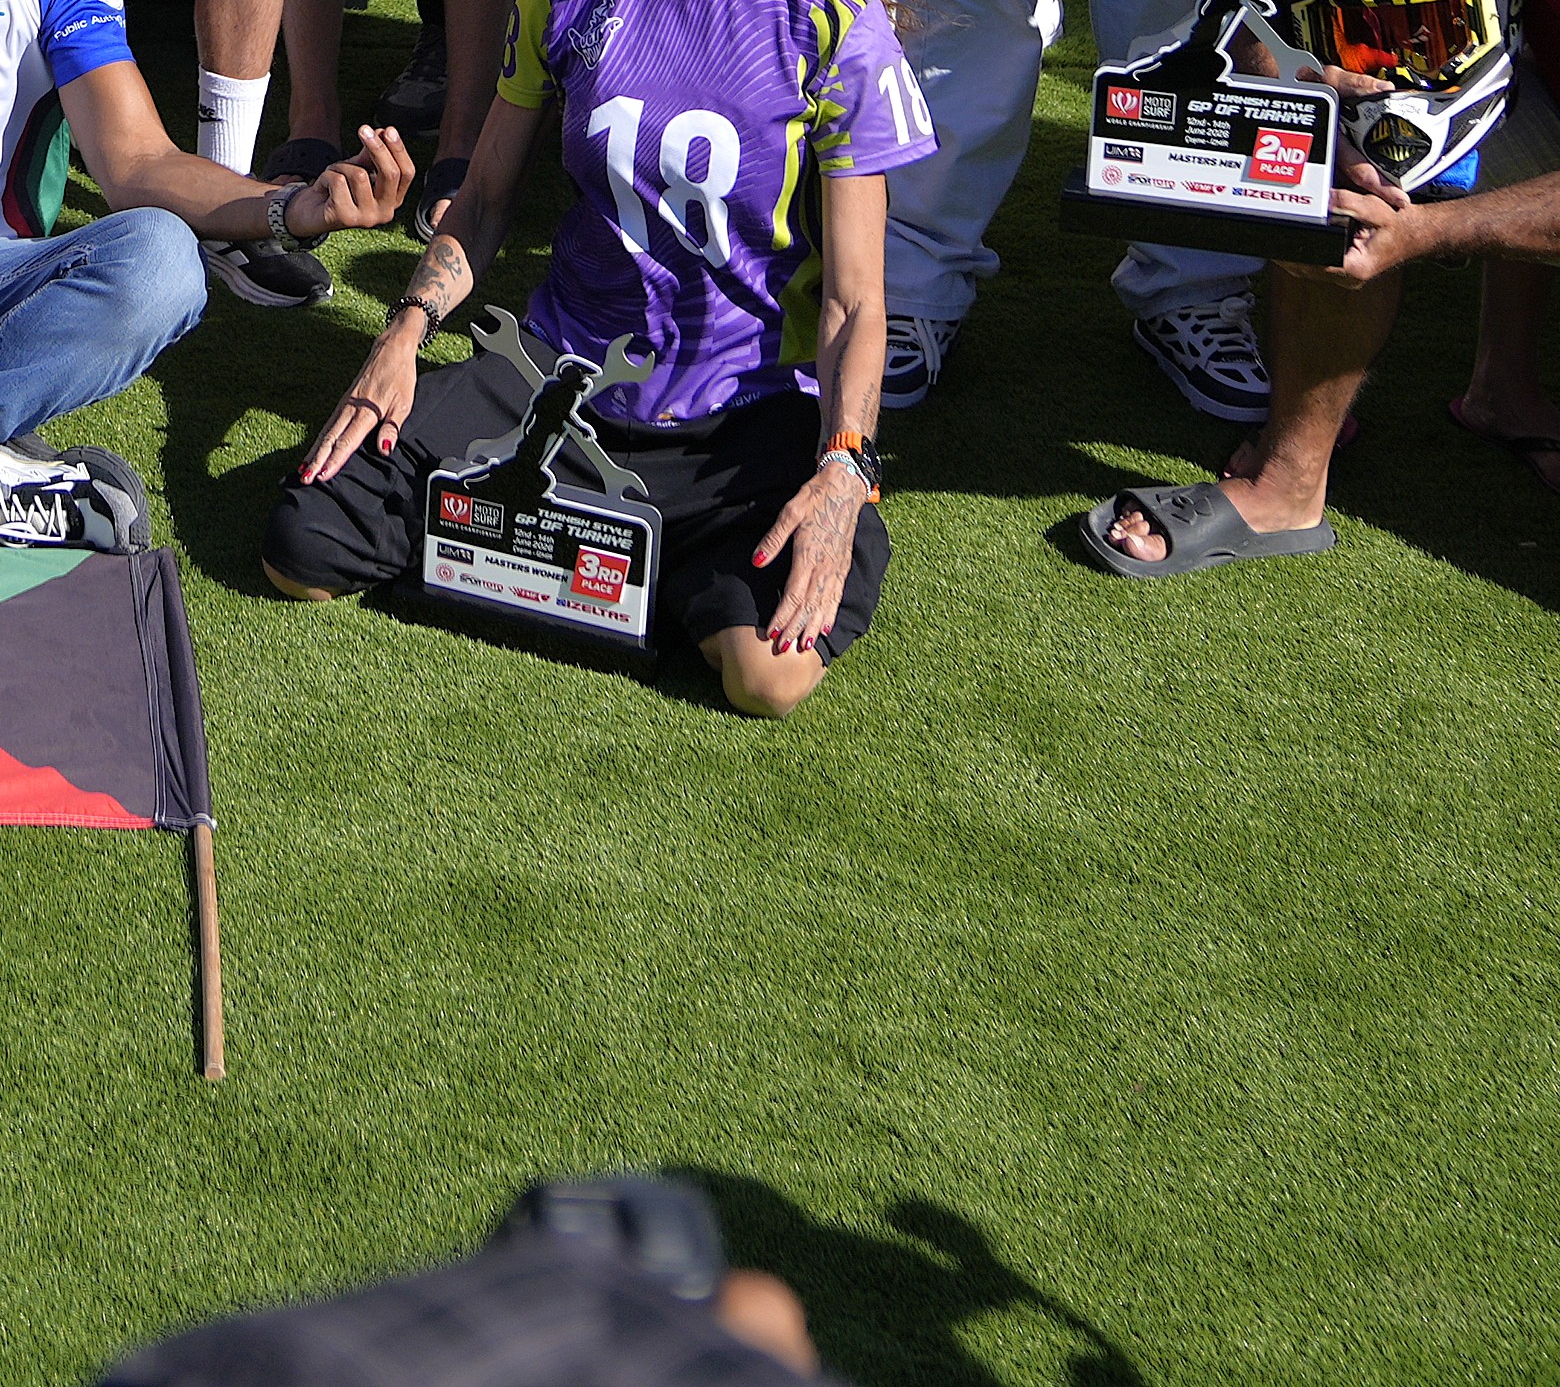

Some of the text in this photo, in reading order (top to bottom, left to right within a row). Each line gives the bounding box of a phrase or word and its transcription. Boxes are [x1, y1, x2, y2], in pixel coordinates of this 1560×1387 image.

[1255, 134, 1307, 164] 2ND
[1259, 162, 1296, 177] PLACE
[586, 94, 742, 270] 18
[1243, 188, 1313, 206] IZELTAS
[578, 552, 624, 585] 3RD
[581, 579, 615, 596] PLACE
